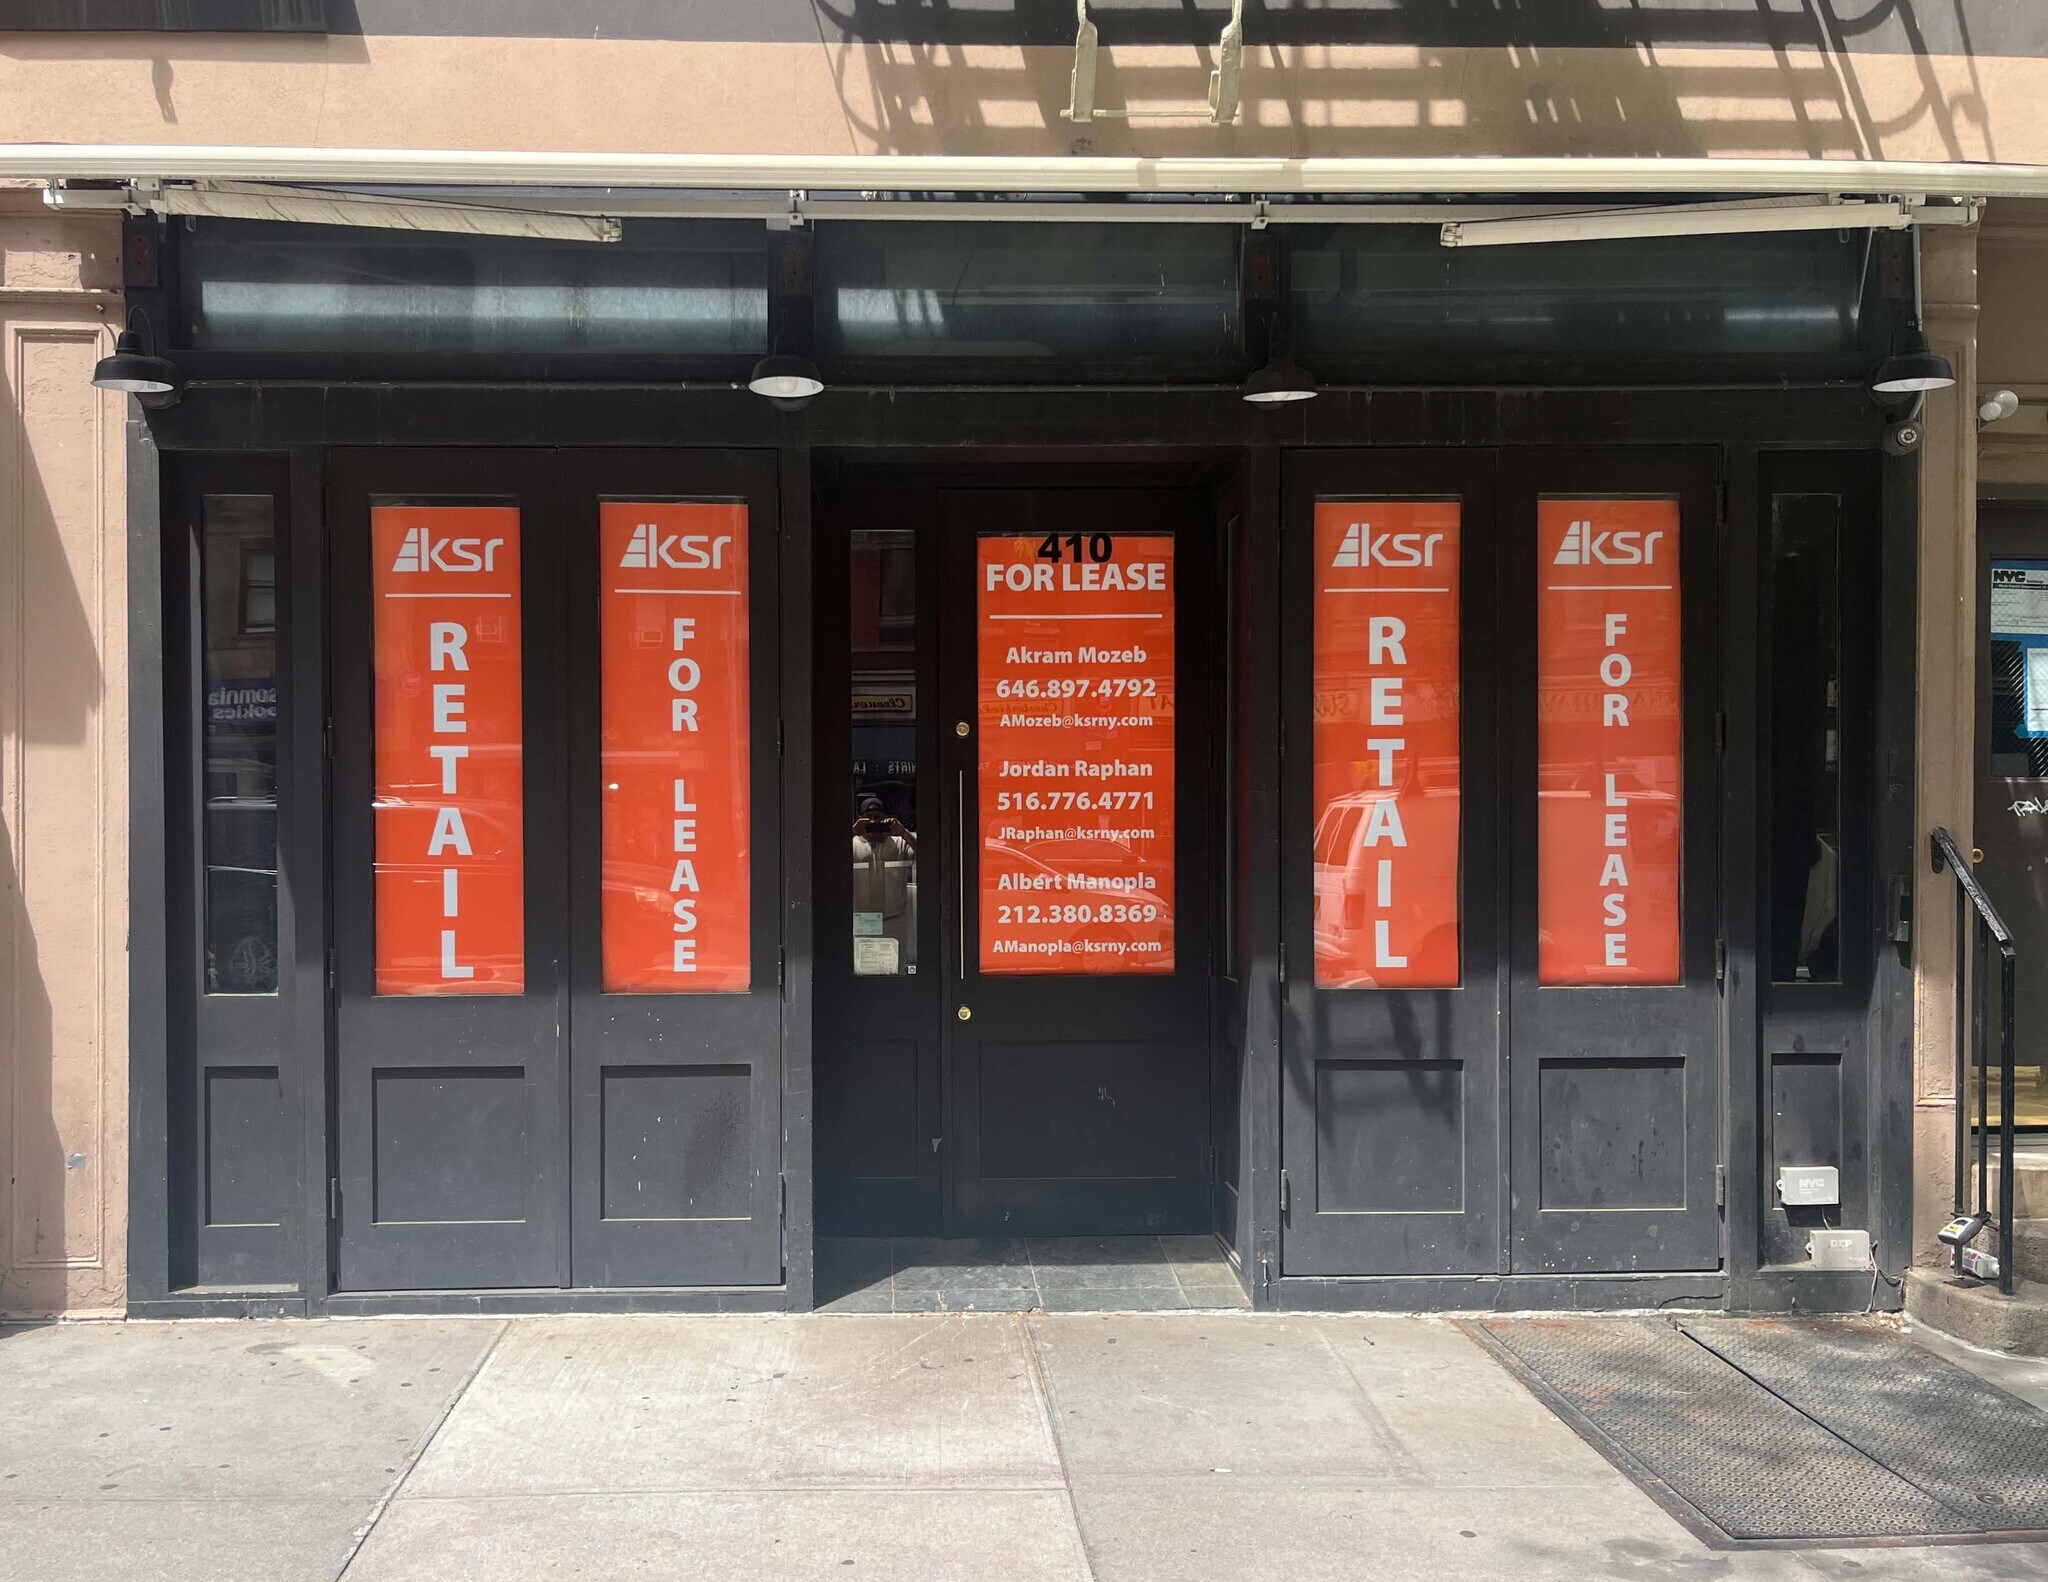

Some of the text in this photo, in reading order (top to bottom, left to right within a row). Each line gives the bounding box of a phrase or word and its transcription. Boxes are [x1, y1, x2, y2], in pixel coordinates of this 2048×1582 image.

[421, 528, 504, 571] ksr
[649, 525, 731, 568] ksr
[1037, 533, 1112, 563] 410
[1362, 524, 1443, 566] ksr
[1583, 522, 1663, 564] ksr
[986, 562, 1166, 592] FOR LEASE
[1993, 570, 2026, 583] NYC
[1006, 646, 1147, 664] Akram Mozeb
[1600, 613, 1632, 727] FOR
[668, 618, 701, 732] FOR
[996, 678, 1156, 698] 646.897.4792
[1000, 713, 1153, 730] AMozeb@ksrny.com
[999, 760, 1070, 777] Jordan
[1074, 759, 1153, 781] Raphan
[428, 622, 475, 979] RETAIL
[997, 791, 1153, 811] 516.776.4771
[1363, 616, 1408, 968] RETAIL
[998, 826, 1155, 843] JRaphan@ksrny.com
[669, 779, 700, 973] LEASE
[998, 872, 1157, 898] Albert Manopla
[1599, 773, 1629, 967] LEASE
[997, 904, 1157, 924] 212.380.8369
[992, 939, 1162, 956] AManopla@ksrny.com
